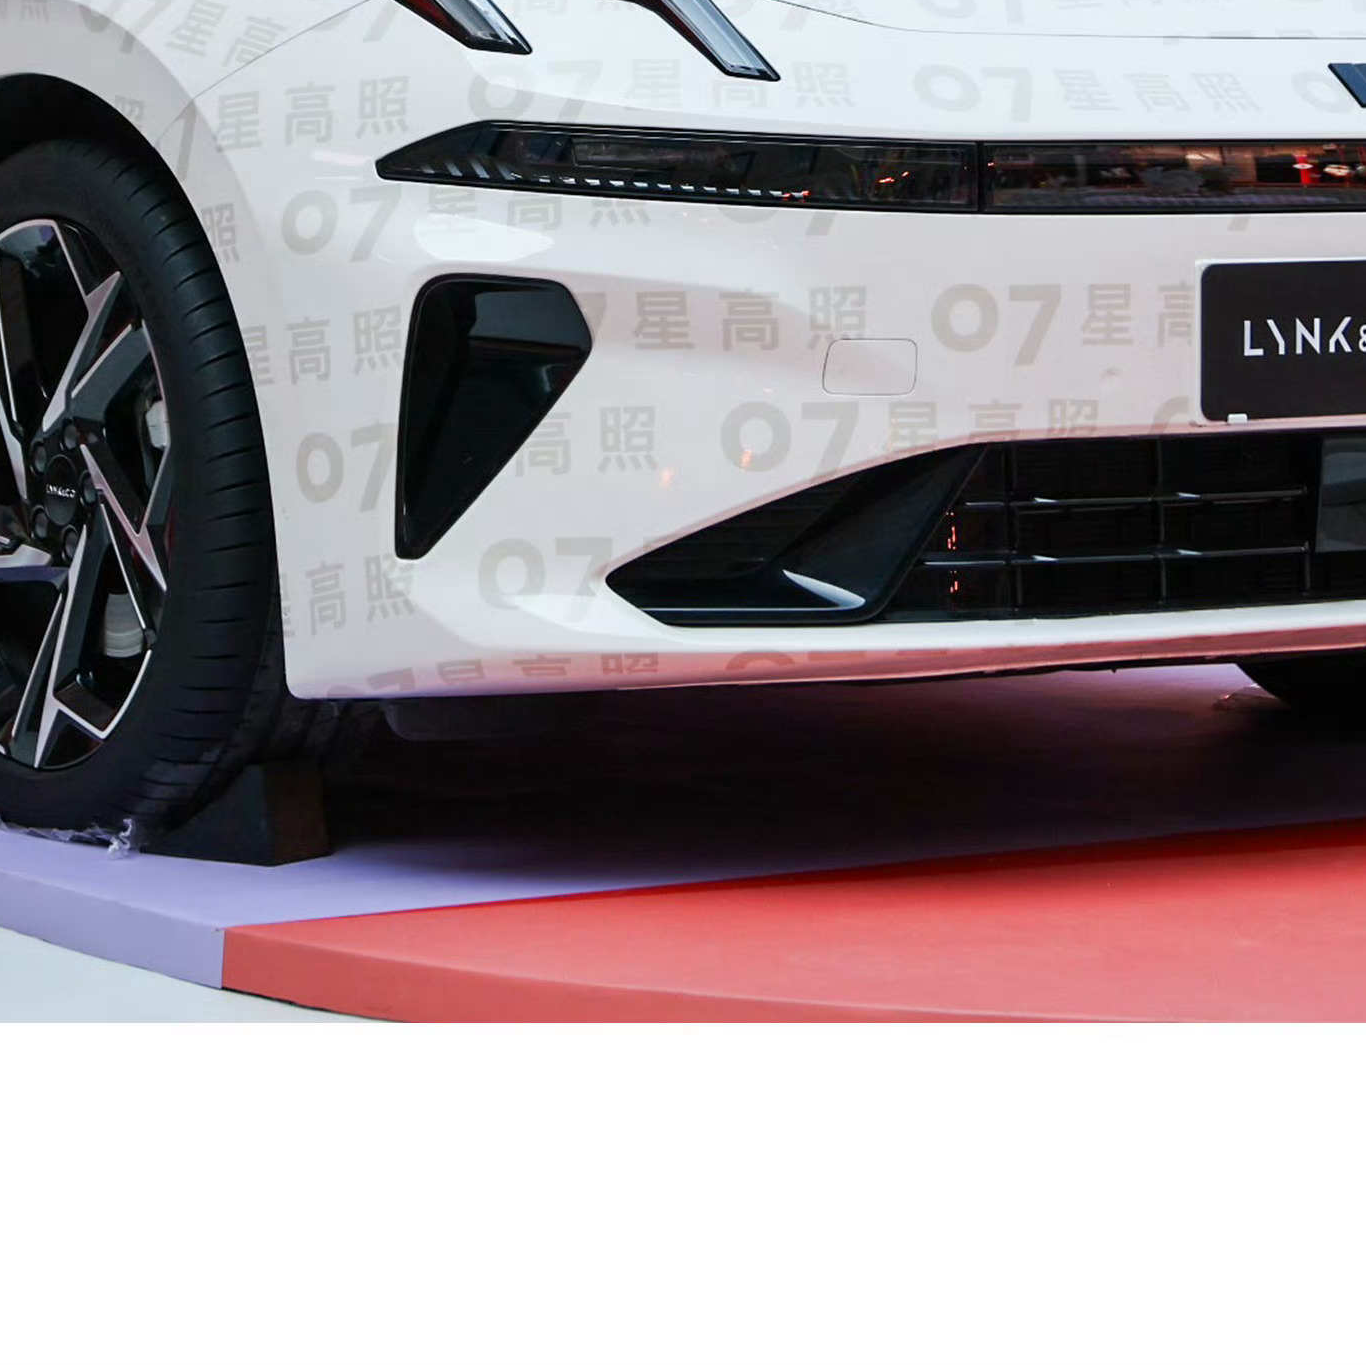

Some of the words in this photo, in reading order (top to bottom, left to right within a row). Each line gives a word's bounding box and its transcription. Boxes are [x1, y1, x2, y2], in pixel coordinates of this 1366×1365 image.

[910, 61, 1263, 123] 07星高照
[930, 281, 1194, 368] 07星高
